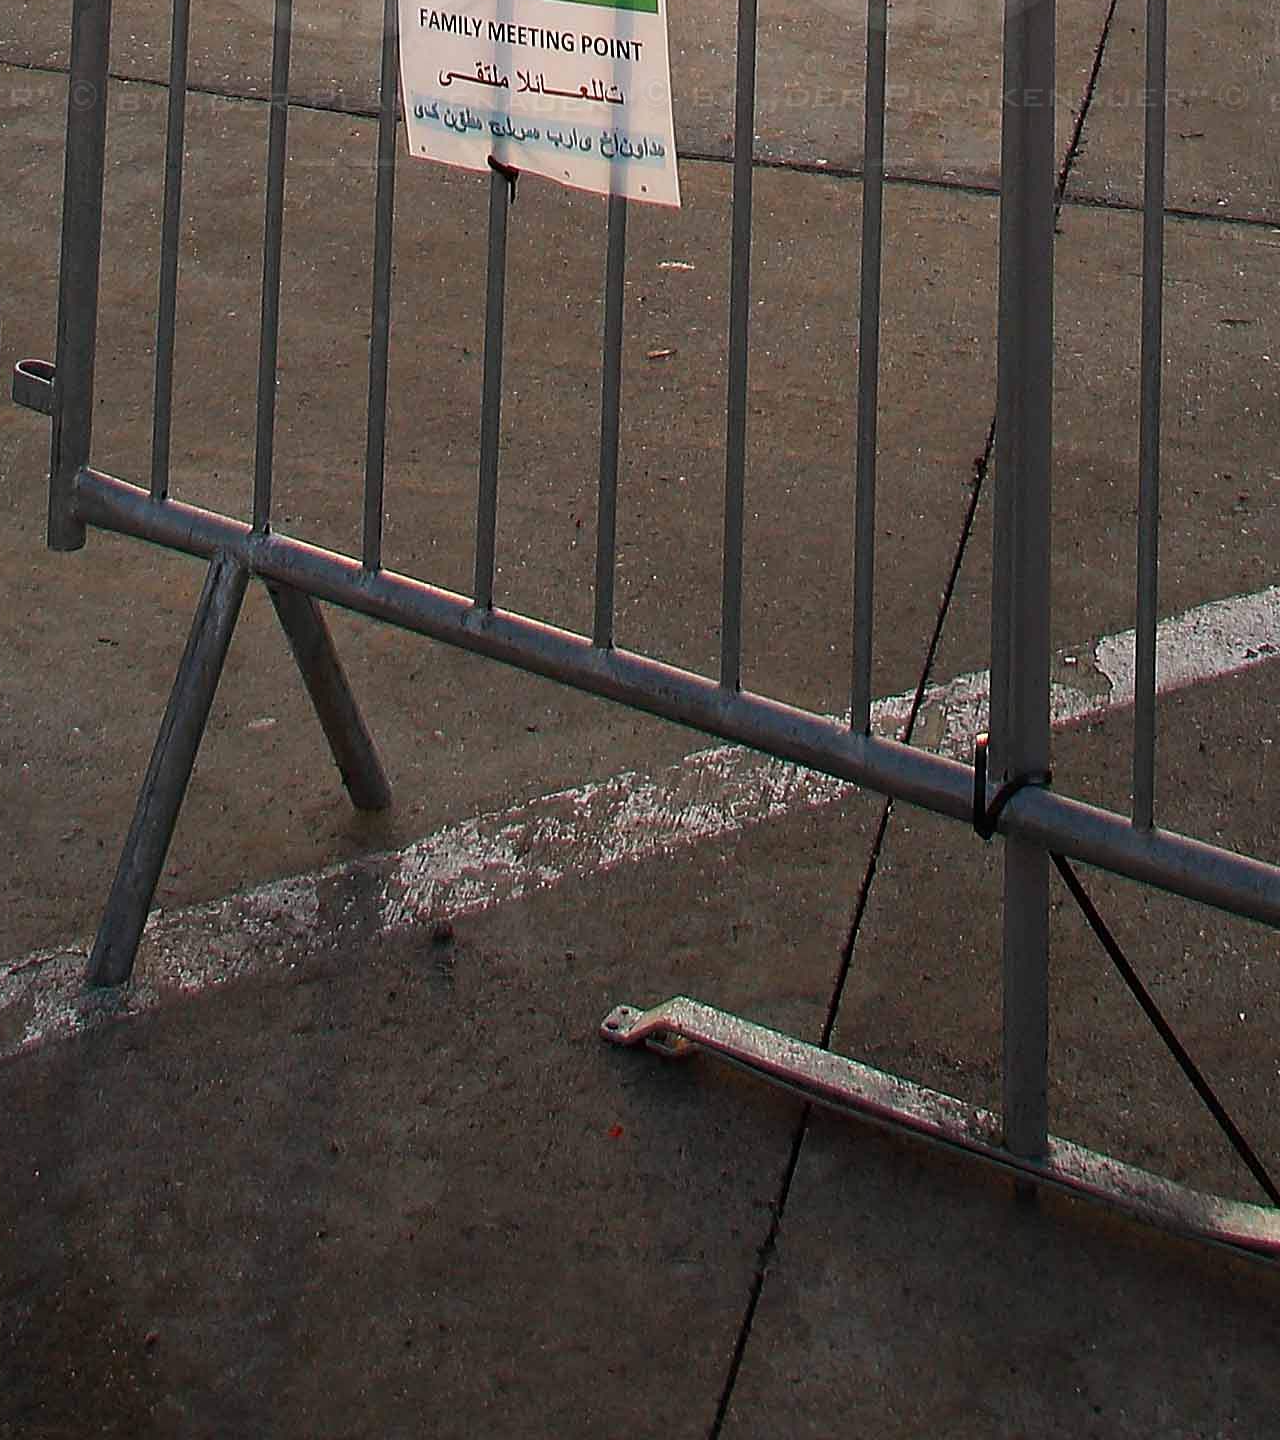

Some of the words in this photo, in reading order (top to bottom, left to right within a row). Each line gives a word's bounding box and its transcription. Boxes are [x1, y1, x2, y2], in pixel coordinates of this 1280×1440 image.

[419, 8, 483, 40] FAMILY
[487, 22, 576, 54] MEETING
[580, 35, 644, 62] POINT
